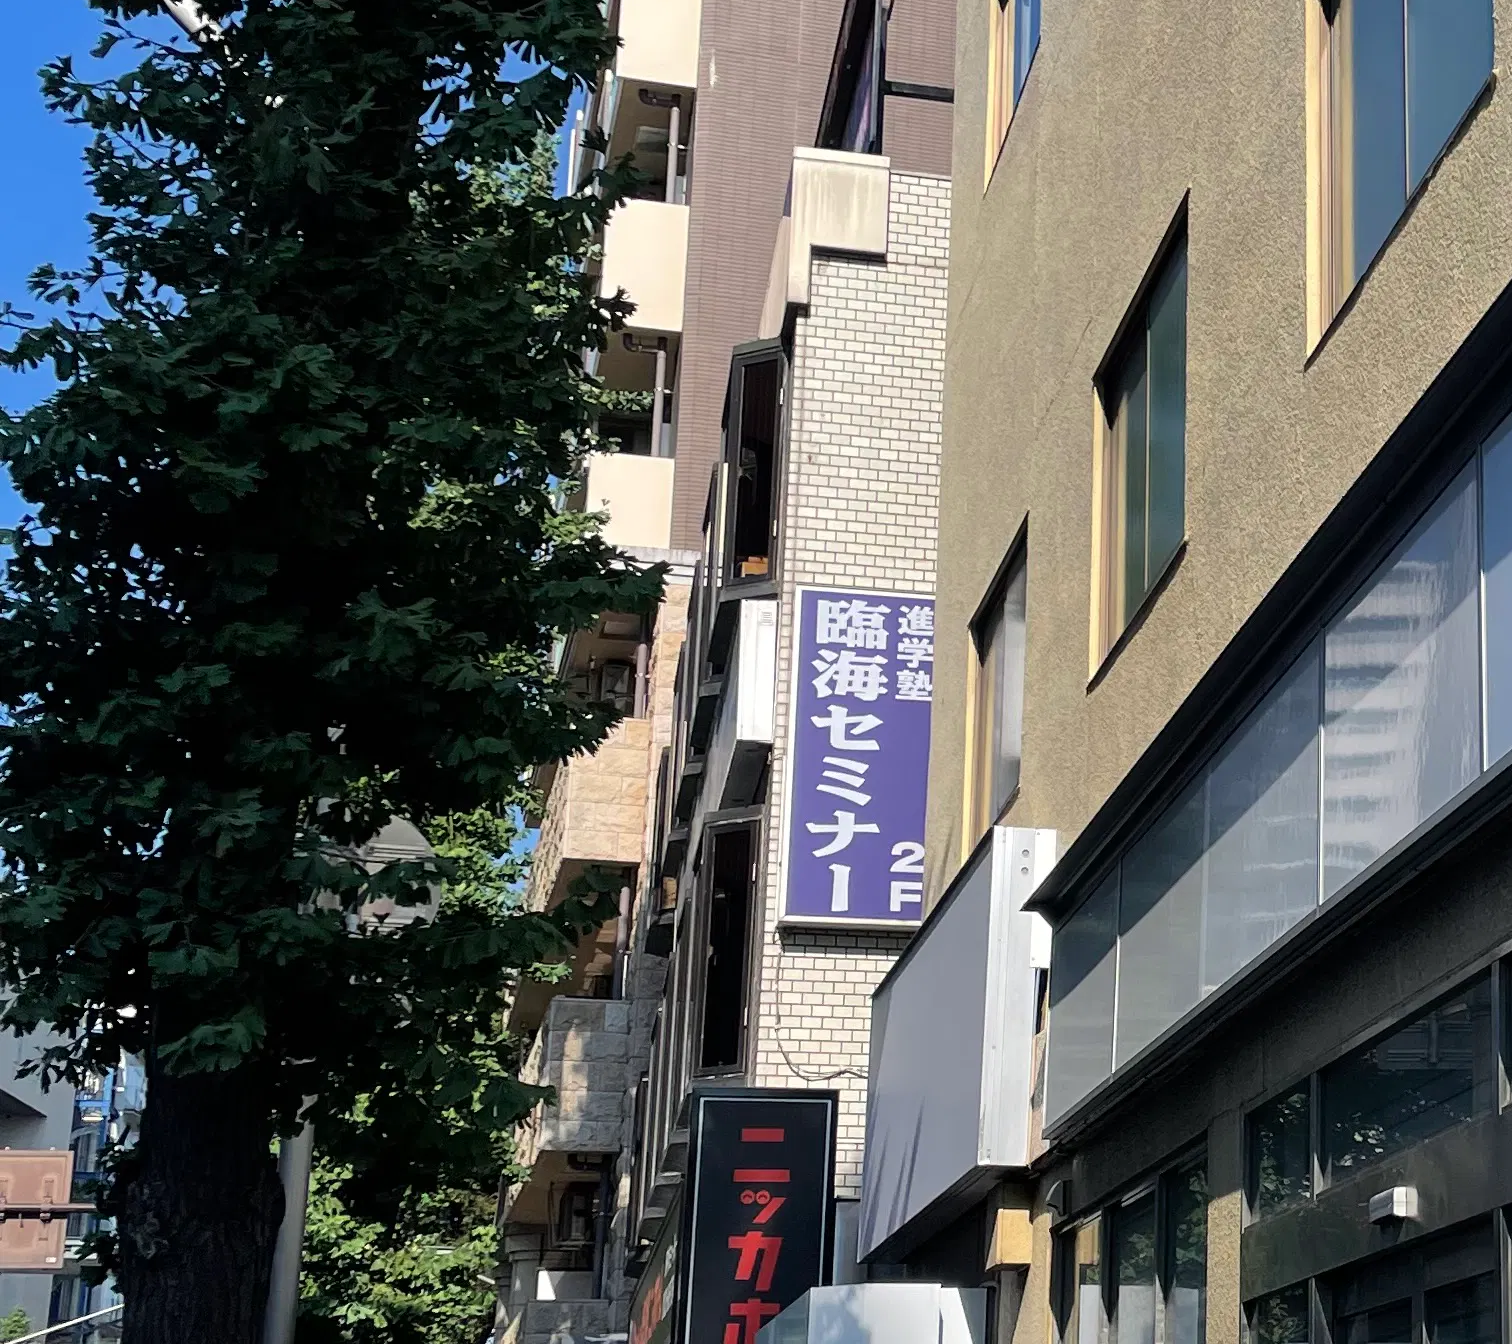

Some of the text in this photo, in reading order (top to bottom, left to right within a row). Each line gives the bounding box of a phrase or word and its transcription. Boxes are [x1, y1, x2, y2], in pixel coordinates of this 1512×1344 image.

[895, 605, 934, 702] 進学塾
[805, 599, 891, 913] 臨海セミナー
[889, 841, 925, 912] 2F
